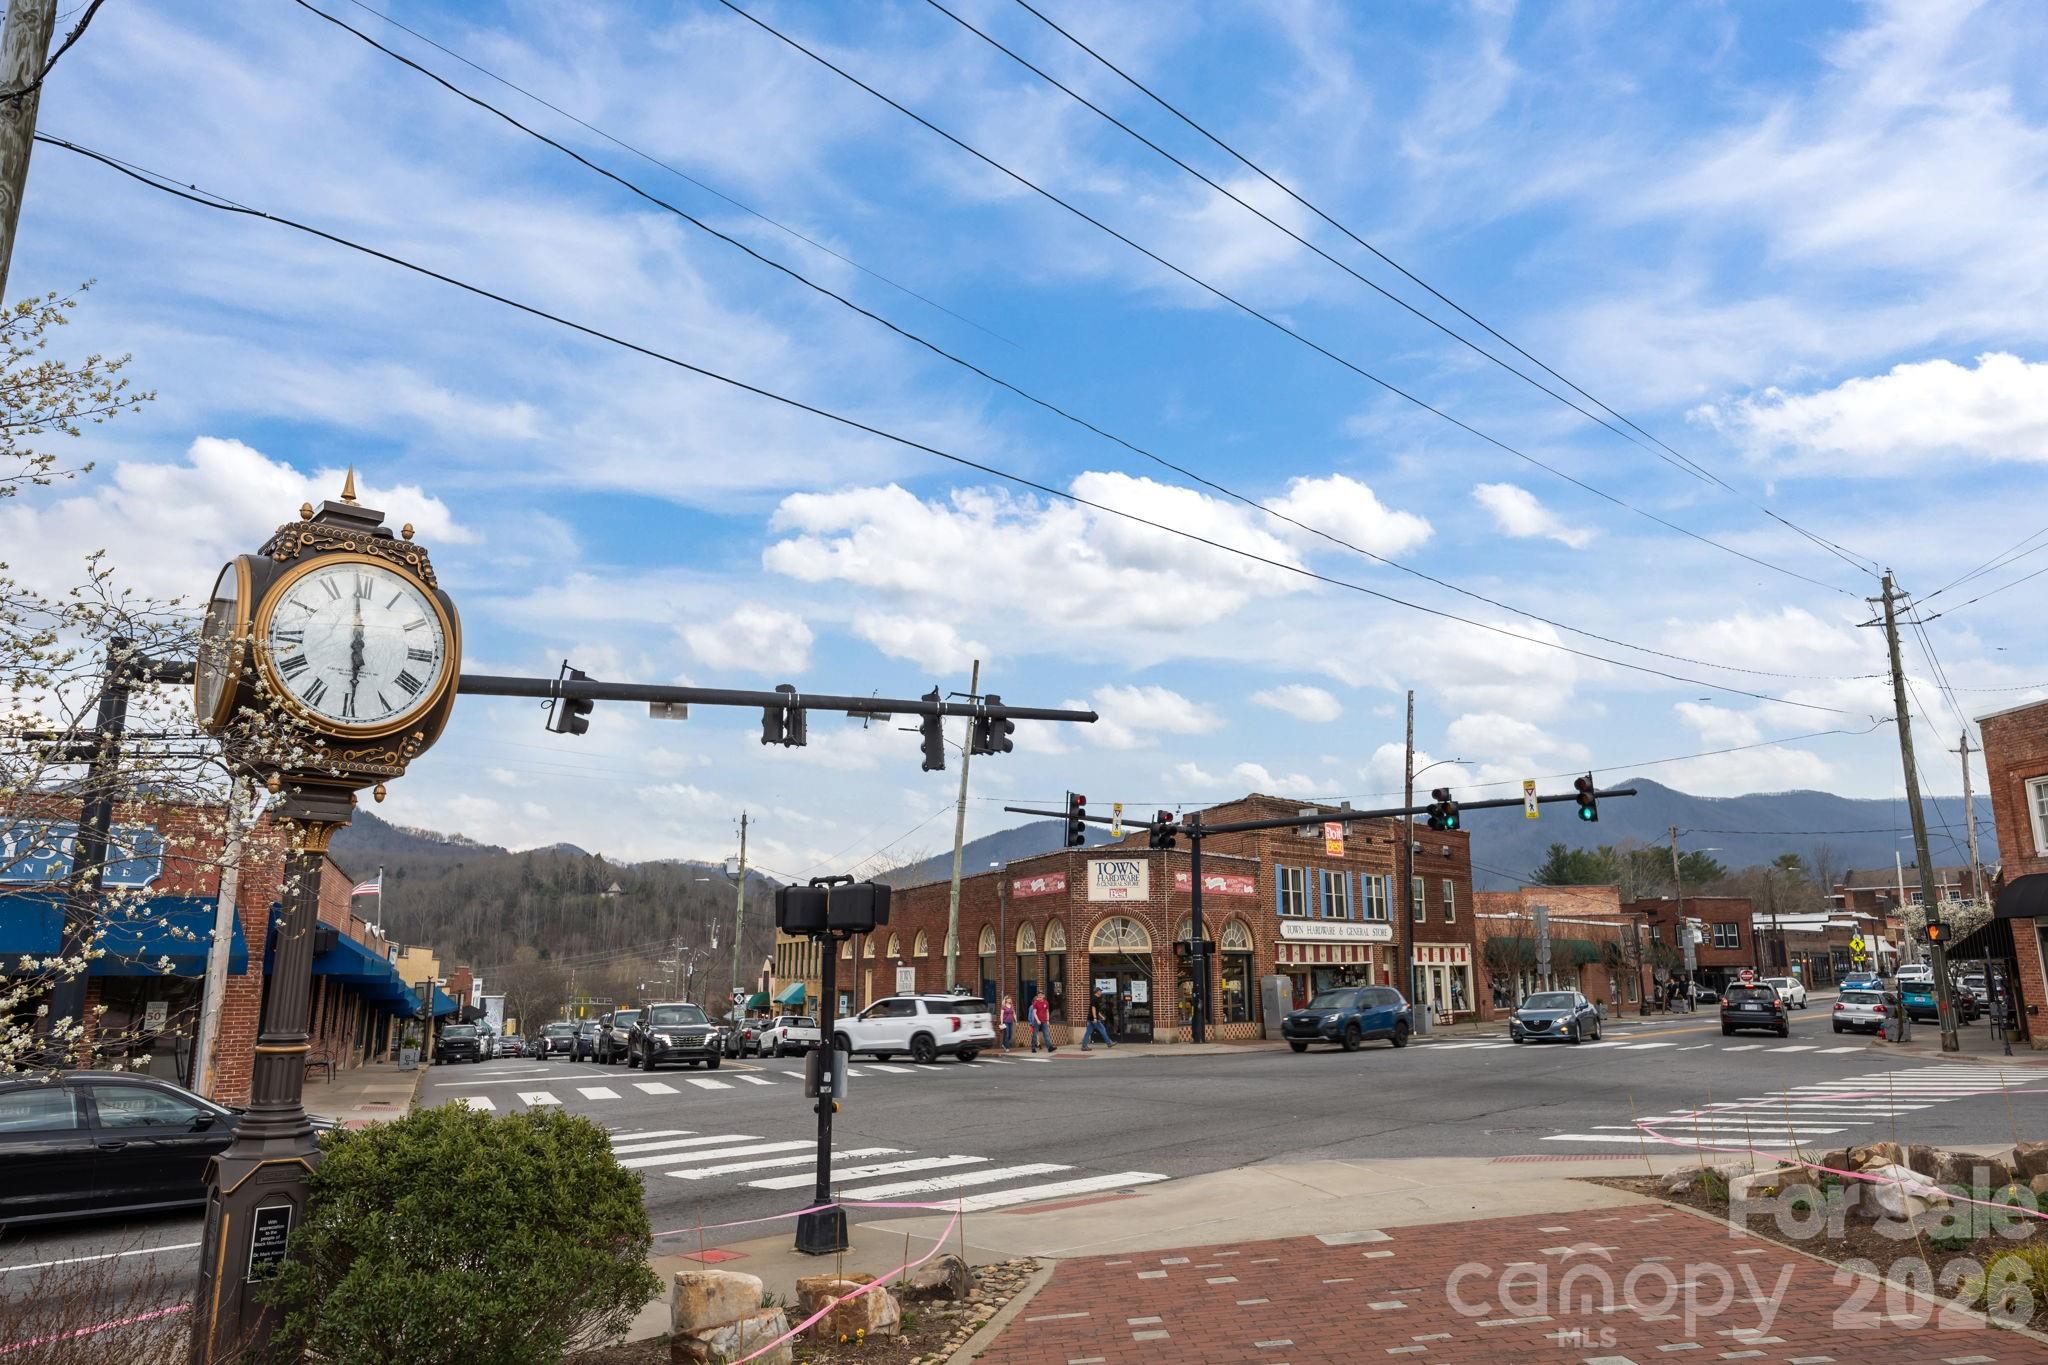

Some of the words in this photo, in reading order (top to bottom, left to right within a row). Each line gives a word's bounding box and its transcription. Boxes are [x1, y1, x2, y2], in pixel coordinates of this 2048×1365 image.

[1095, 861, 1140, 875] TOWN
[1097, 874, 1140, 882] HARDWARE
[1287, 925, 1304, 935] TOWN
[1307, 925, 1335, 936] HARDWARE
[1346, 926, 1370, 937] GENERAL
[1372, 928, 1388, 937] STORE
